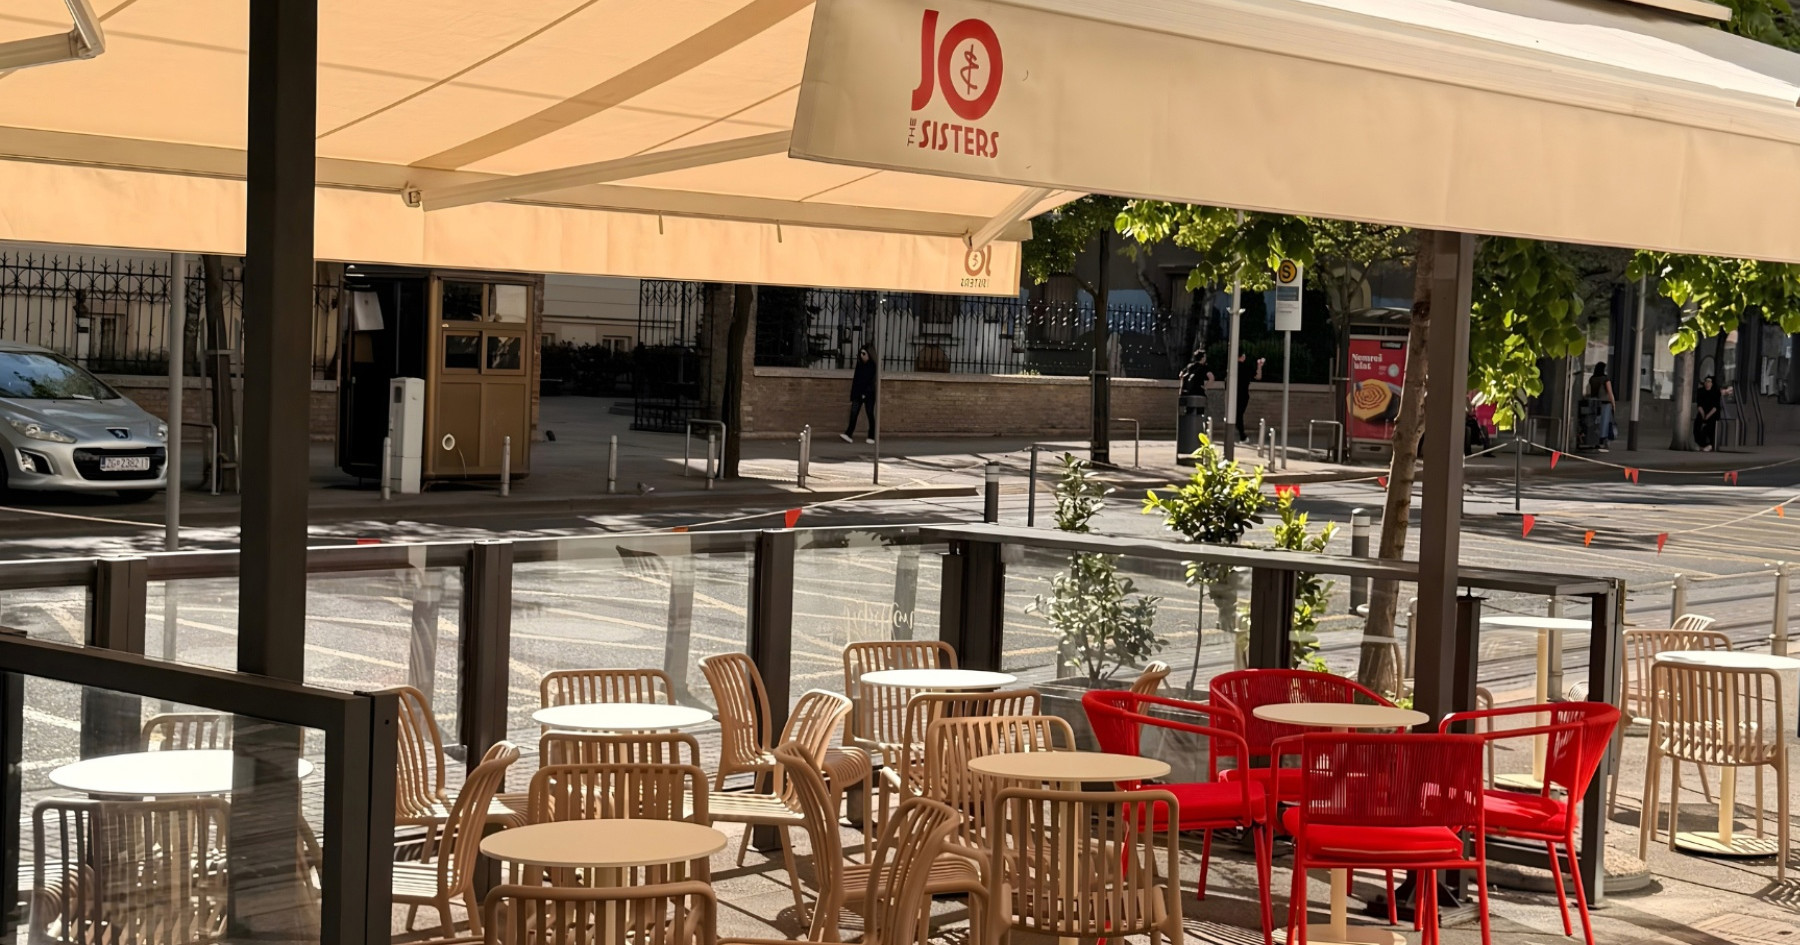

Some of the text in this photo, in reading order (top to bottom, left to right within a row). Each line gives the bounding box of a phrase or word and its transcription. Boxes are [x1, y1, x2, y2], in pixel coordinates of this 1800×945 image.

[911, 9, 1003, 121] JO
[907, 117, 917, 147] THE
[919, 120, 999, 158] SISTERS
[1282, 264, 1291, 279] S
